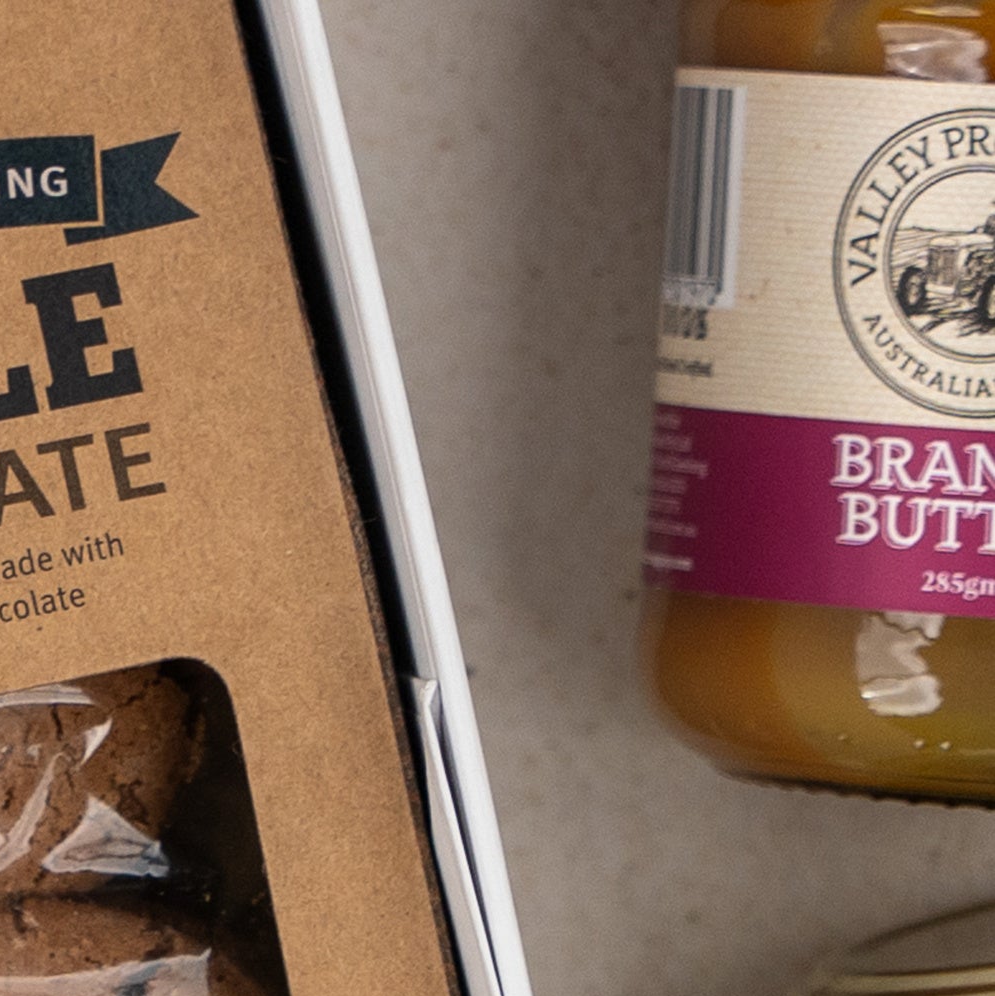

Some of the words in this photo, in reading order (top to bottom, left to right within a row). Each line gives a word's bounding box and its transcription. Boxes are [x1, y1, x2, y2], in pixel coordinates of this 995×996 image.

[848, 136, 934, 287] VALLEY
[862, 314, 995, 398] AUSTRALIA
[61, 533, 124, 566] with
